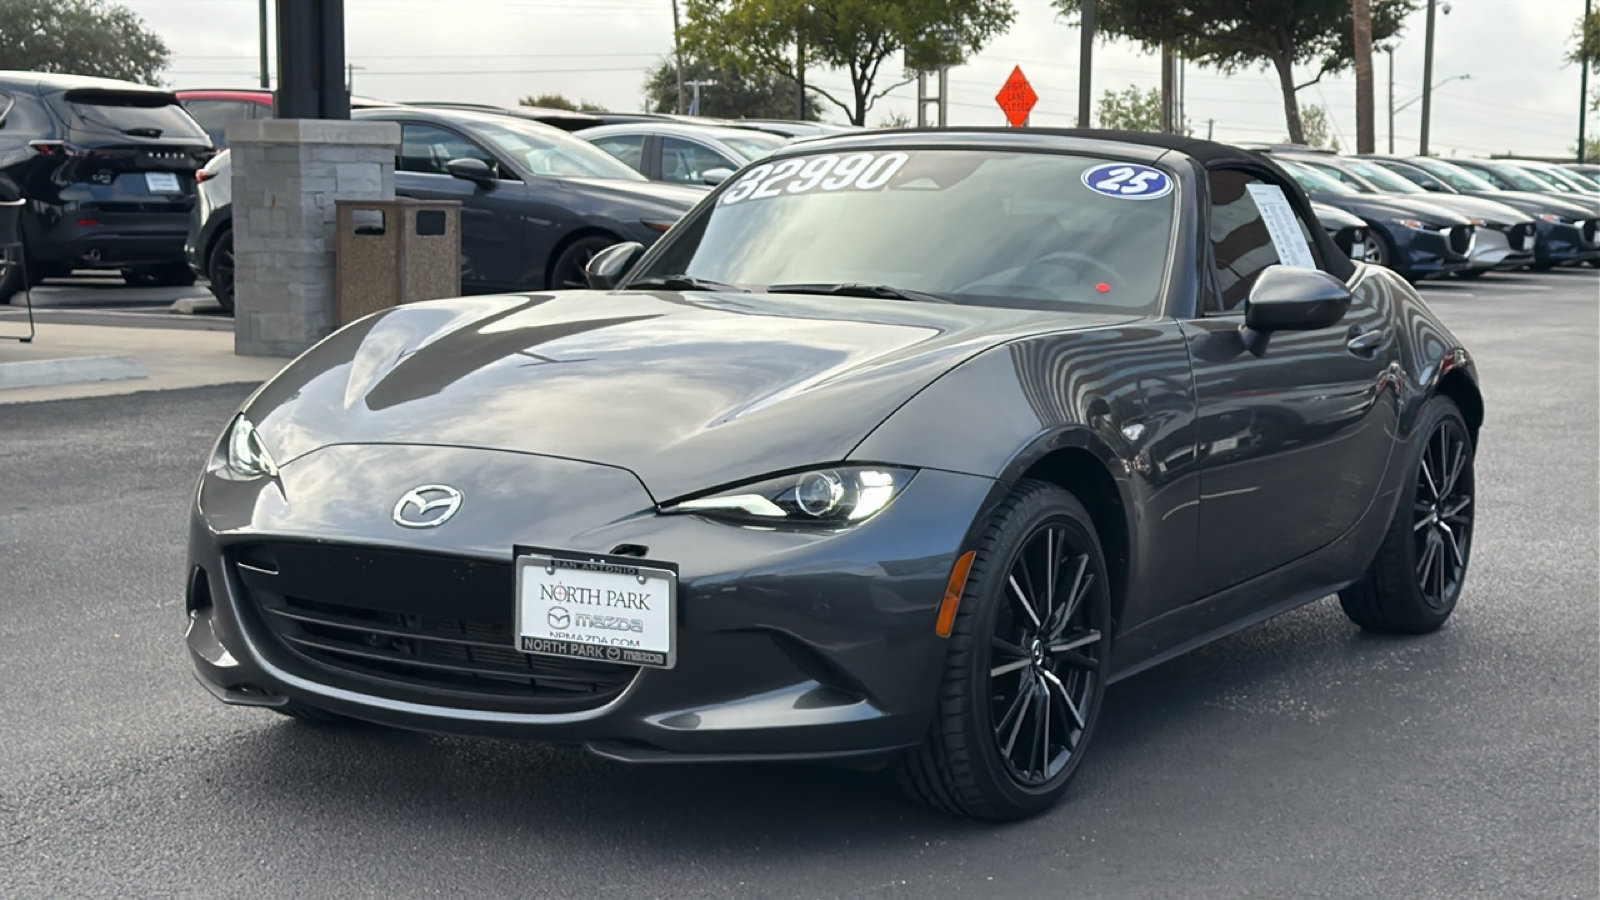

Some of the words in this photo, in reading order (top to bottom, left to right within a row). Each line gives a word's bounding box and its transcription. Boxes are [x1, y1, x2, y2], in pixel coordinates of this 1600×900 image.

[1003, 102, 1030, 111] CLOSED
[1008, 91, 1025, 101] LANE
[724, 152, 909, 204] 32990
[1096, 167, 1160, 194] 25
[554, 560, 577, 569] SAN
[582, 563, 636, 575] ANTONIO
[540, 583, 600, 606] NORTH
[607, 590, 651, 611] PARK
[524, 638, 567, 653] NORTH
[570, 643, 604, 659] PARK
